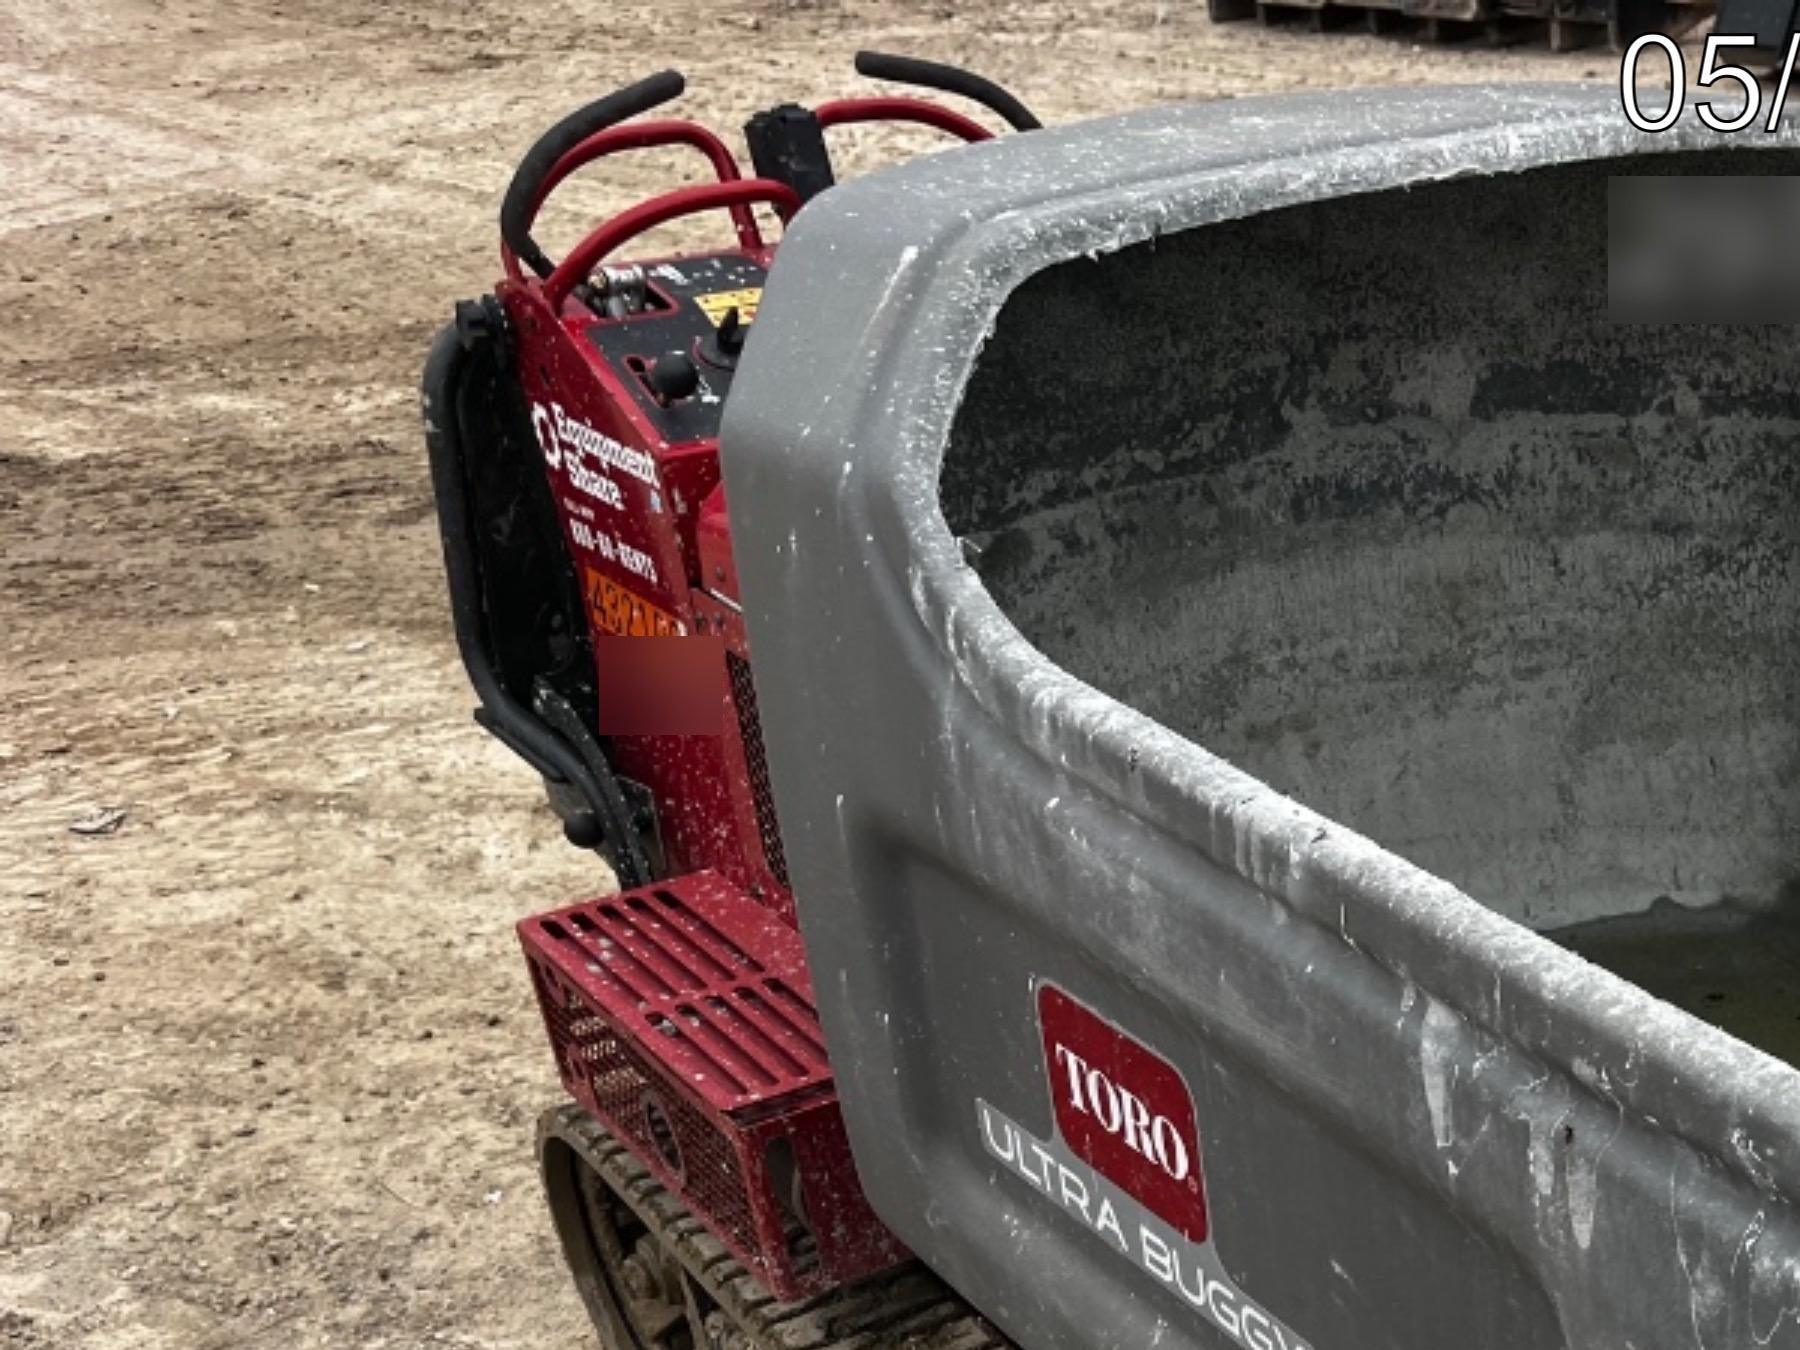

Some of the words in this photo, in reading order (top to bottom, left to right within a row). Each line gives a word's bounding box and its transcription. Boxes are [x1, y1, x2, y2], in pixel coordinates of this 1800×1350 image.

[551, 402, 660, 489] Equipment
[983, 1108, 1128, 1253] ULTRA
[1055, 1043, 1190, 1182] TORO
